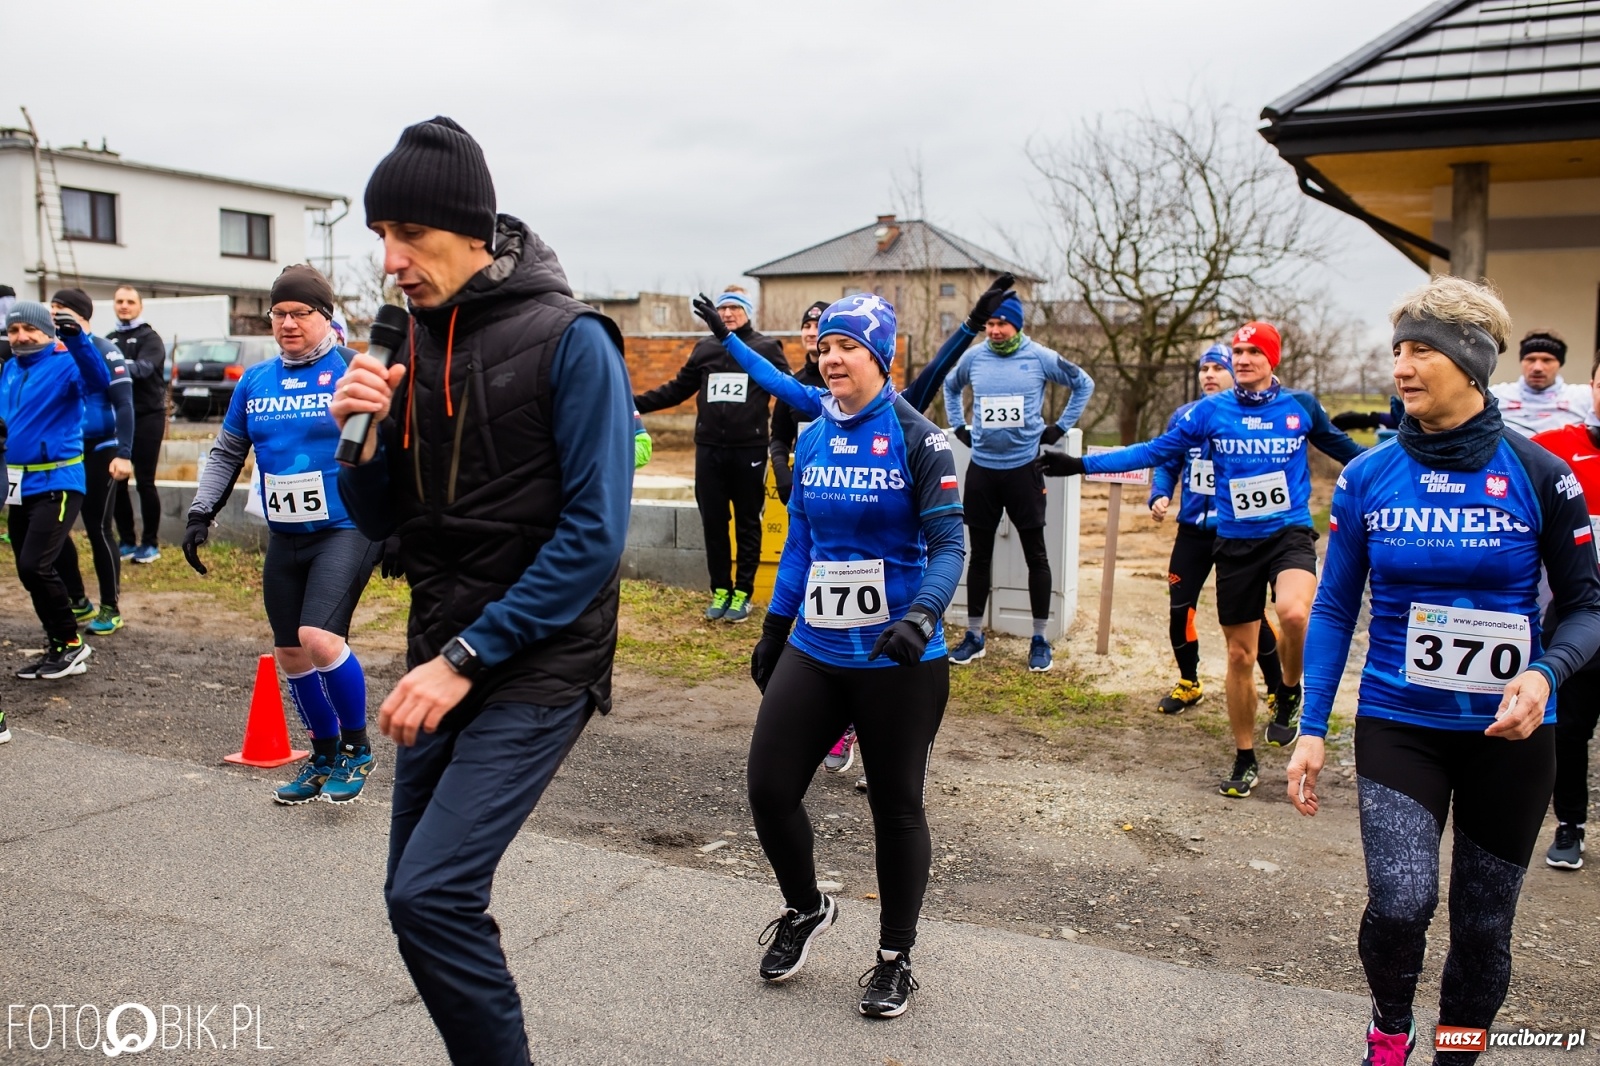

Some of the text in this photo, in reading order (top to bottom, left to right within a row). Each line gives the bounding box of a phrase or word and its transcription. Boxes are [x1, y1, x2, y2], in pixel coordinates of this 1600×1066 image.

[711, 383, 743, 396] 142
[245, 392, 334, 415] RUNNER
[300, 410, 326, 418] TEAM
[984, 407, 1021, 422] 233
[1194, 472, 1216, 489] 19
[268, 490, 322, 513] 415
[849, 493, 879, 503] TEAM
[1235, 487, 1286, 511] 396
[767, 523, 782, 534] 992
[1460, 538, 1501, 548] TEAM
[828, 568, 880, 576] www.personalbest.pl
[810, 585, 881, 616] 170
[1453, 617, 1526, 631] www.personalbest.pl
[1413, 634, 1521, 680] 370
